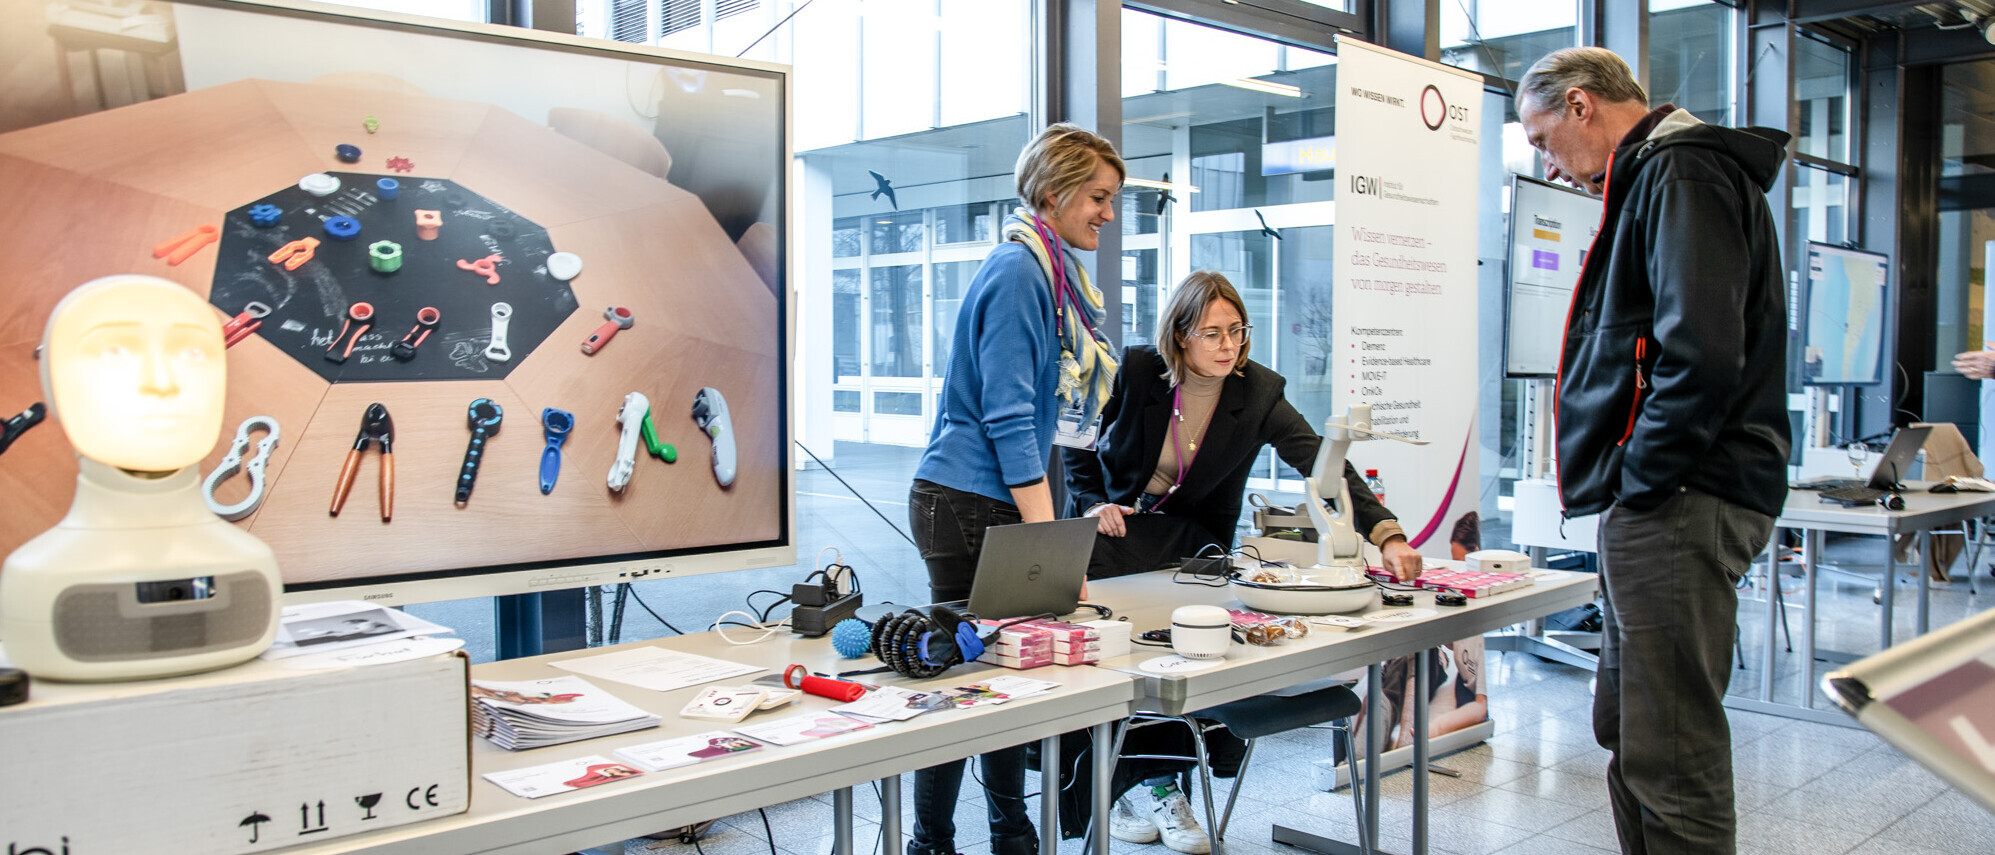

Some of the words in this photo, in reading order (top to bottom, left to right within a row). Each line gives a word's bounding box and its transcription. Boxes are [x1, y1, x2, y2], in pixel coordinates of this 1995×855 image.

[1351, 87, 1362, 97] WO
[1363, 89, 1385, 102] WISSEN
[1449, 105, 1469, 122] OST
[1351, 175, 1378, 196] IGW
[1351, 226, 1385, 244] Wissen
[1351, 250, 1370, 267] das
[1372, 252, 1447, 273] Gesundheitswesen
[1351, 278, 1372, 291] von
[1374, 279, 1403, 296] morgen
[1405, 280, 1442, 297] gestalten
[1361, 341, 1386, 351] Demenz
[1402, 356, 1431, 366] Healthcare
